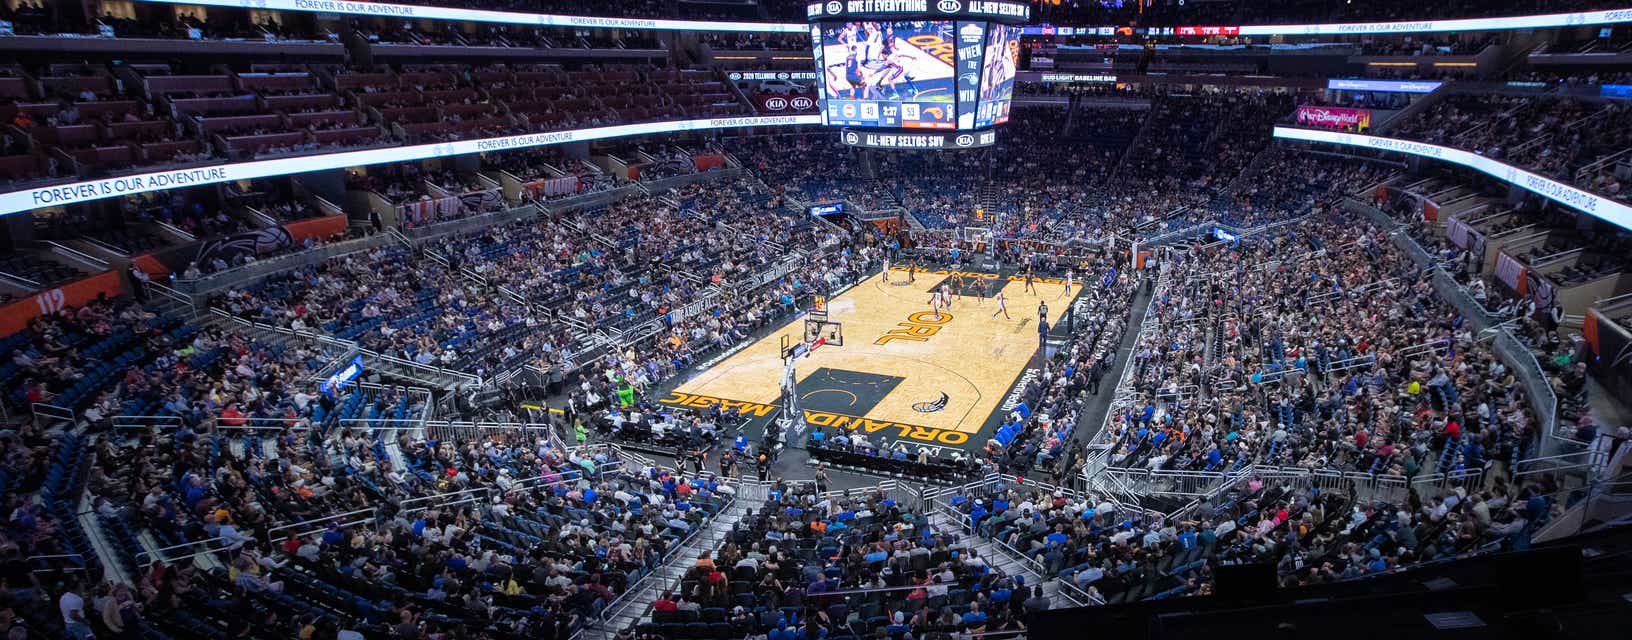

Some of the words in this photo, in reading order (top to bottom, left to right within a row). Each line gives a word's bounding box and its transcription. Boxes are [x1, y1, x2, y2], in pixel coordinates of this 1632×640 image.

[295, 0, 337, 10] FOREVER
[337, 3, 345, 11] IS
[346, 3, 367, 13] OUR
[367, 5, 414, 15] ADVENTURE
[847, 0, 865, 12] GIVE
[866, 0, 873, 12] IT
[875, 0, 927, 12] EVERYTHING
[940, 1, 959, 11] KIA
[968, 1, 998, 14] ALL-NEW
[1605, 11, 1632, 20] FOREVE
[620, 19, 656, 27] ADVENTURE
[1338, 23, 1367, 31] FOREVER
[1376, 23, 1391, 31] OUR
[1392, 22, 1433, 30] ADVENTURE
[958, 44, 982, 60] WHEN
[967, 61, 977, 69] THE
[959, 89, 975, 102] WIN
[769, 99, 784, 108] KIA
[794, 98, 809, 108] KIA
[711, 118, 737, 126] FOREVER
[759, 116, 796, 124] ADVENTURE
[477, 139, 509, 150] FOREVER
[511, 138, 518, 146] IS
[518, 137, 535, 145] OUR
[535, 132, 573, 143] ADVENTURE
[866, 135, 897, 146] ALL-NEW
[897, 136, 928, 147] SELTOS
[928, 136, 944, 147] SUV
[32, 184, 97, 205] FOREVER
[99, 182, 112, 195] IS
[115, 178, 145, 193] OUR
[148, 167, 227, 187] ADVENTURE
[37, 288, 64, 315] 112
[873, 311, 954, 346] ORL
[803, 409, 969, 445] ORLAND
